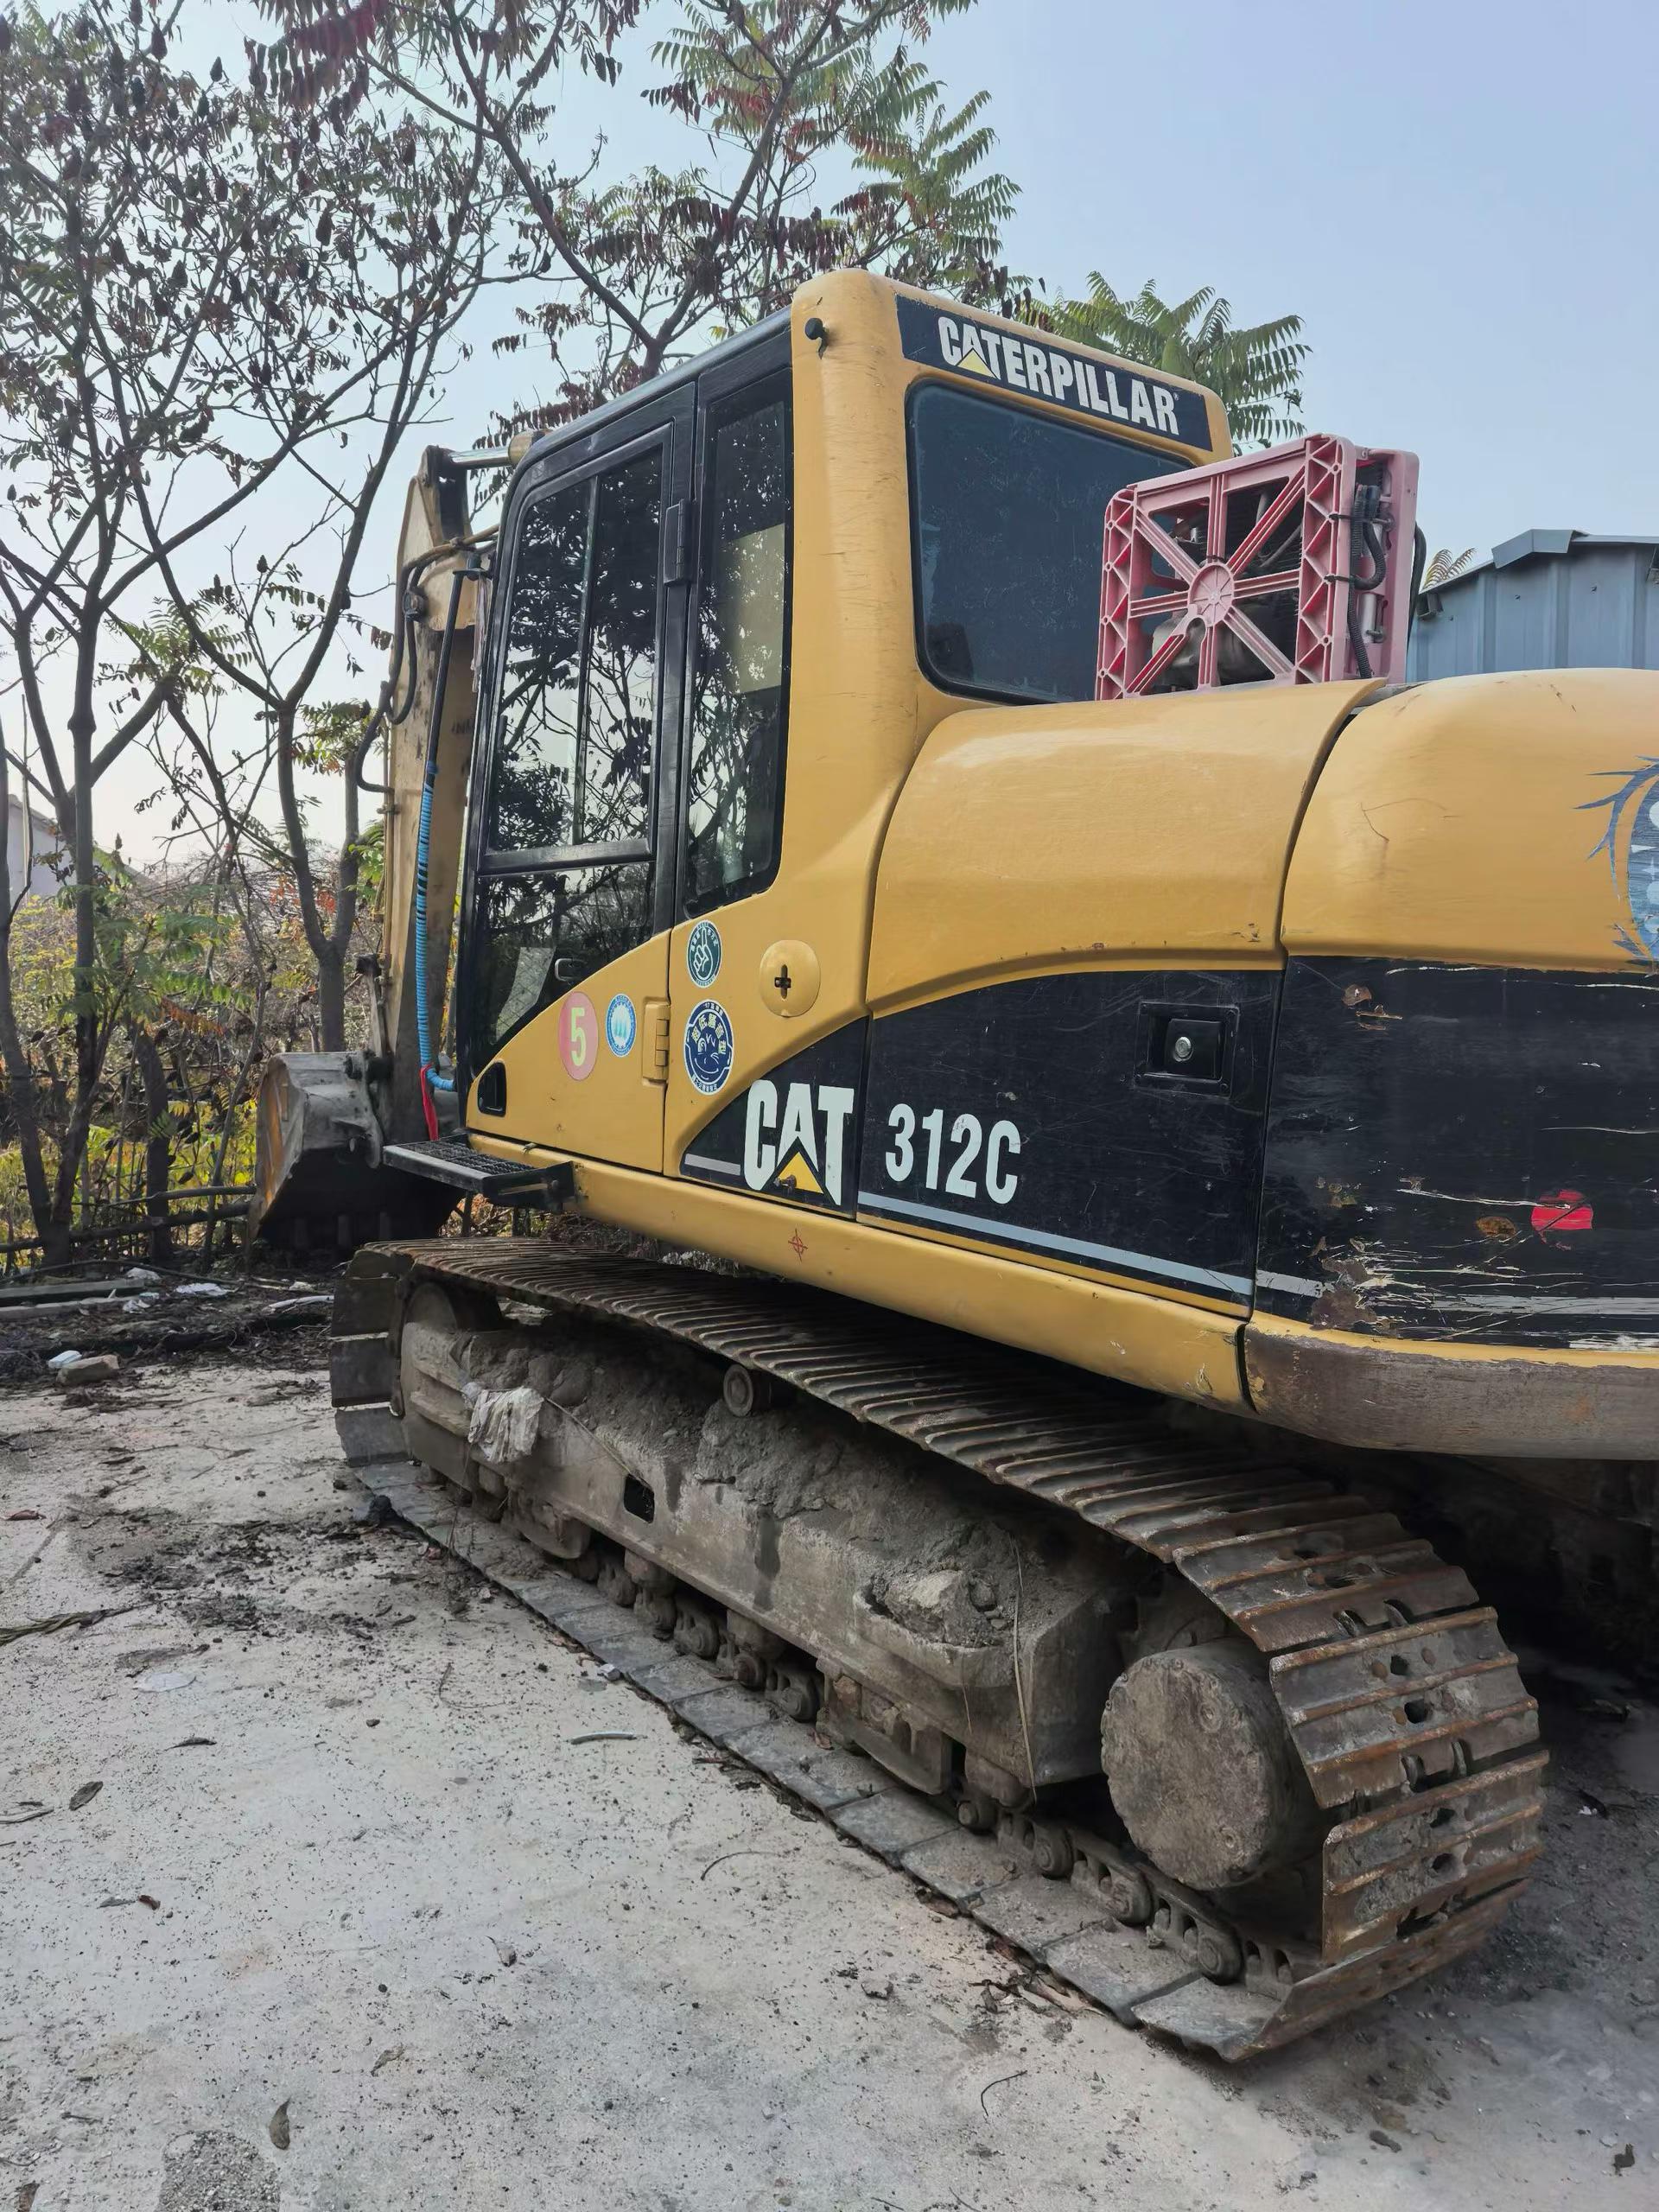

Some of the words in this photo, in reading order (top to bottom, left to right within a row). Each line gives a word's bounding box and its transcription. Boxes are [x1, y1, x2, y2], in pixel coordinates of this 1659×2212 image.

[938, 315, 1179, 435] CATERPILLAR
[571, 1007, 587, 1066] 5
[743, 1079, 855, 1206] CAT
[884, 1103, 1021, 1205] 312C
